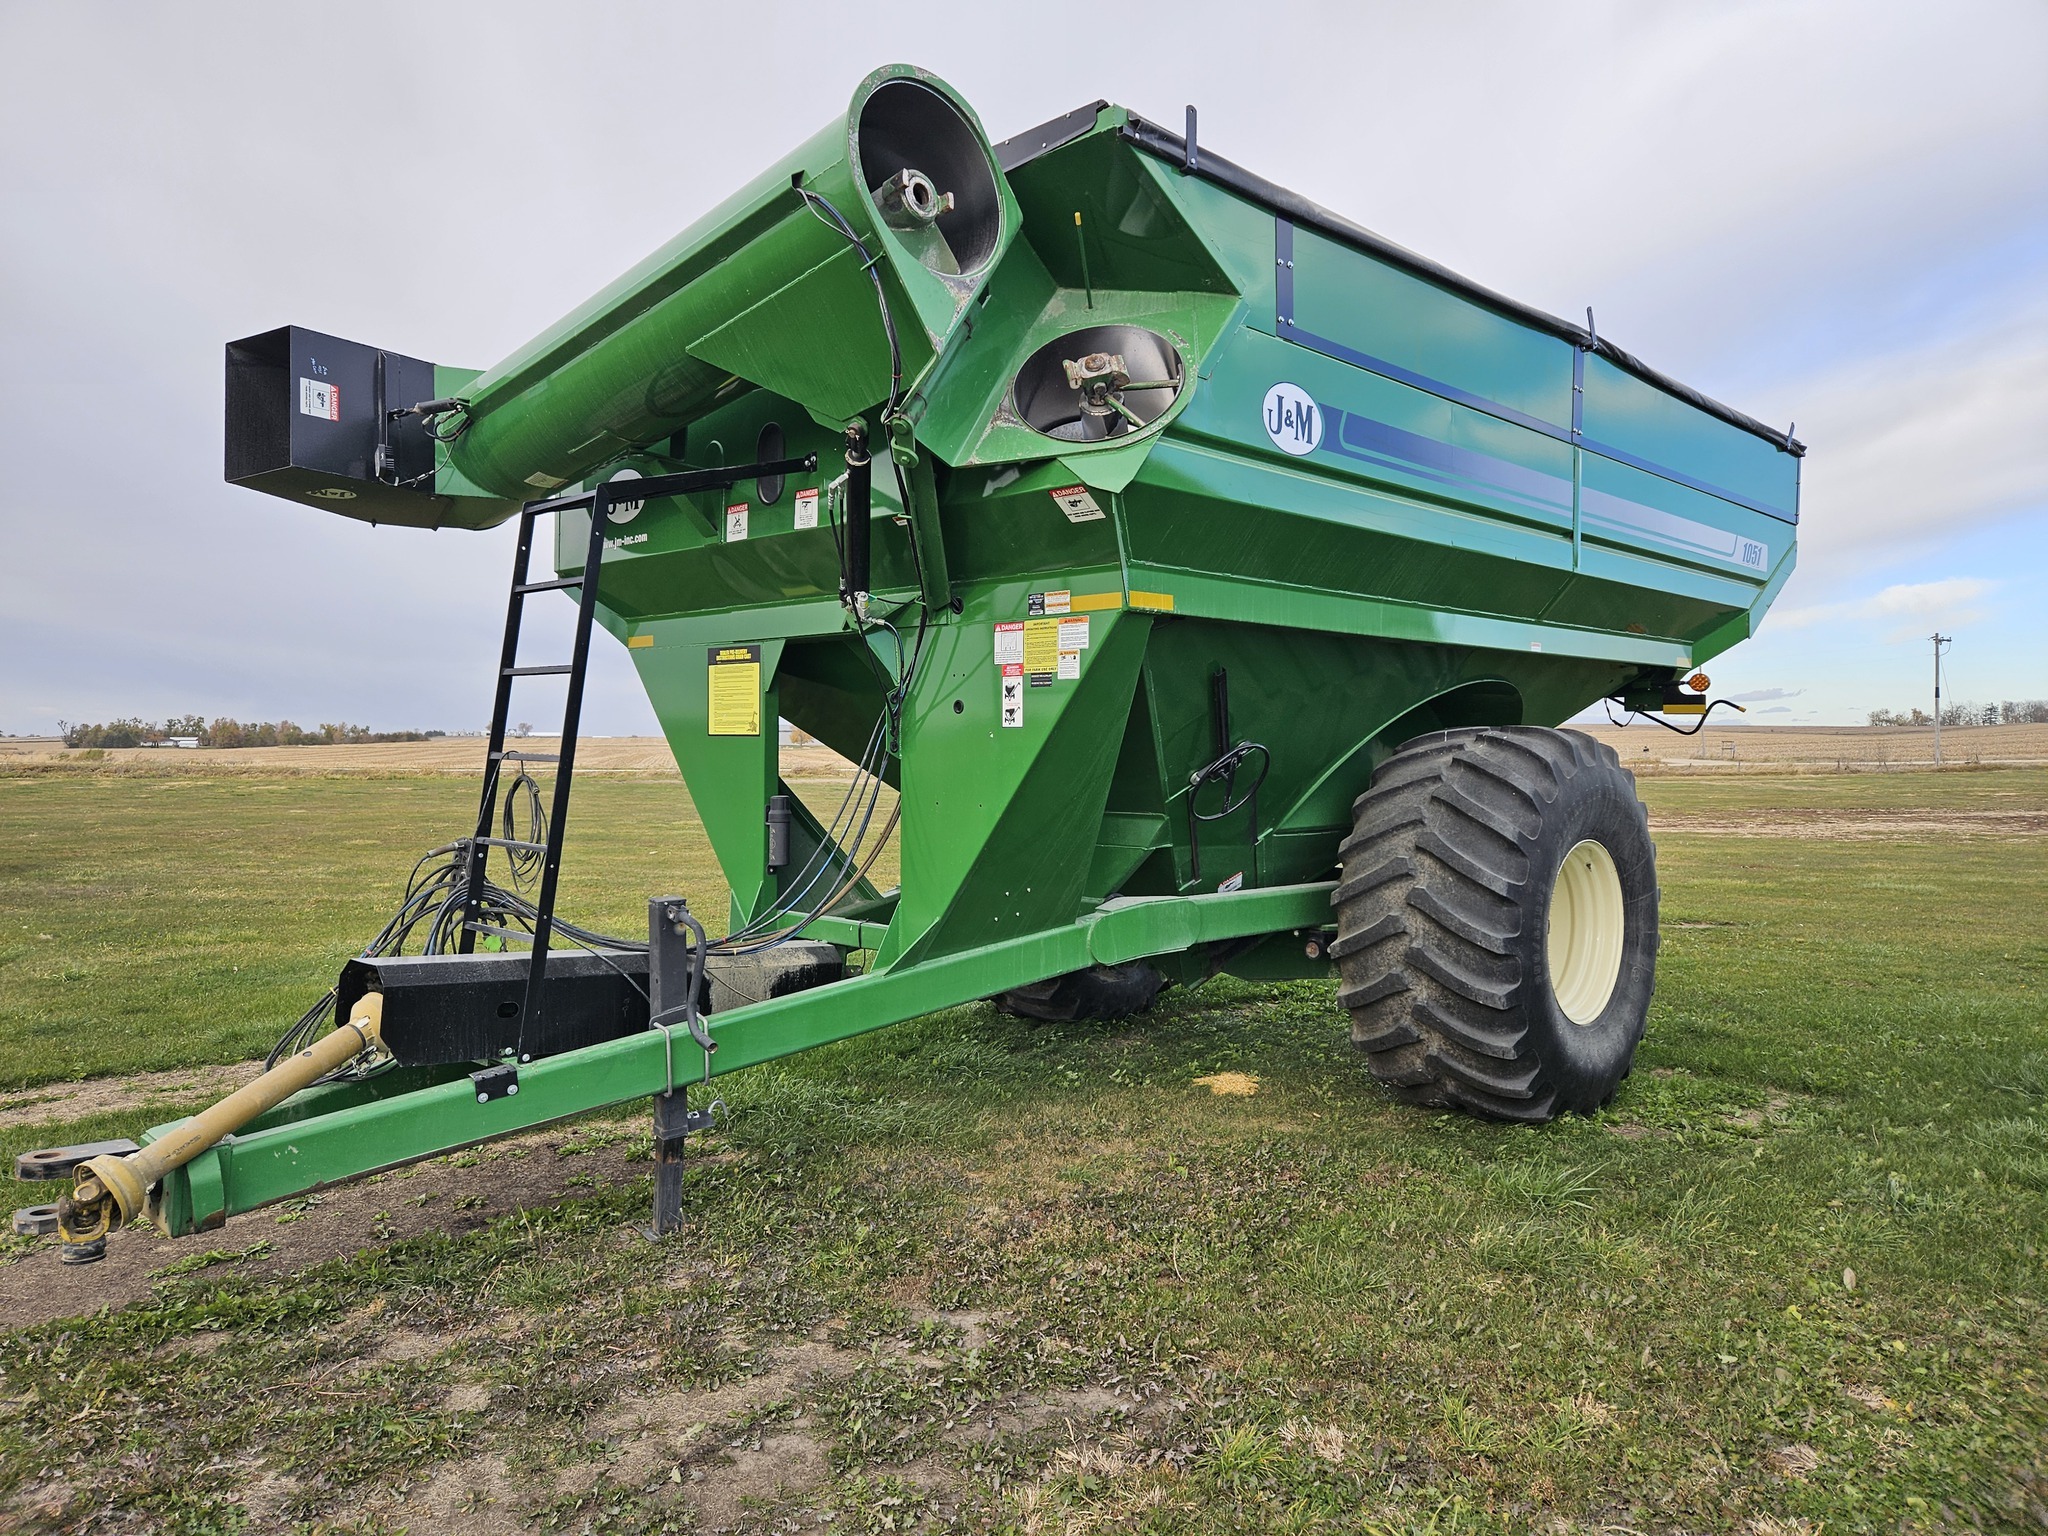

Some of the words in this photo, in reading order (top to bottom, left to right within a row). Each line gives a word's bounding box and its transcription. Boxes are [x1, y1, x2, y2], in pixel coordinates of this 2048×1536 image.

[1267, 394, 1313, 445] J&M
[799, 488, 818, 498] DANGER
[1057, 486, 1086, 497] DANGER
[731, 503, 748, 514] DANGER
[603, 533, 648, 550] ww.jm-inc.com
[1742, 542, 1762, 566] 1051
[1001, 623, 1023, 631] DANGER
